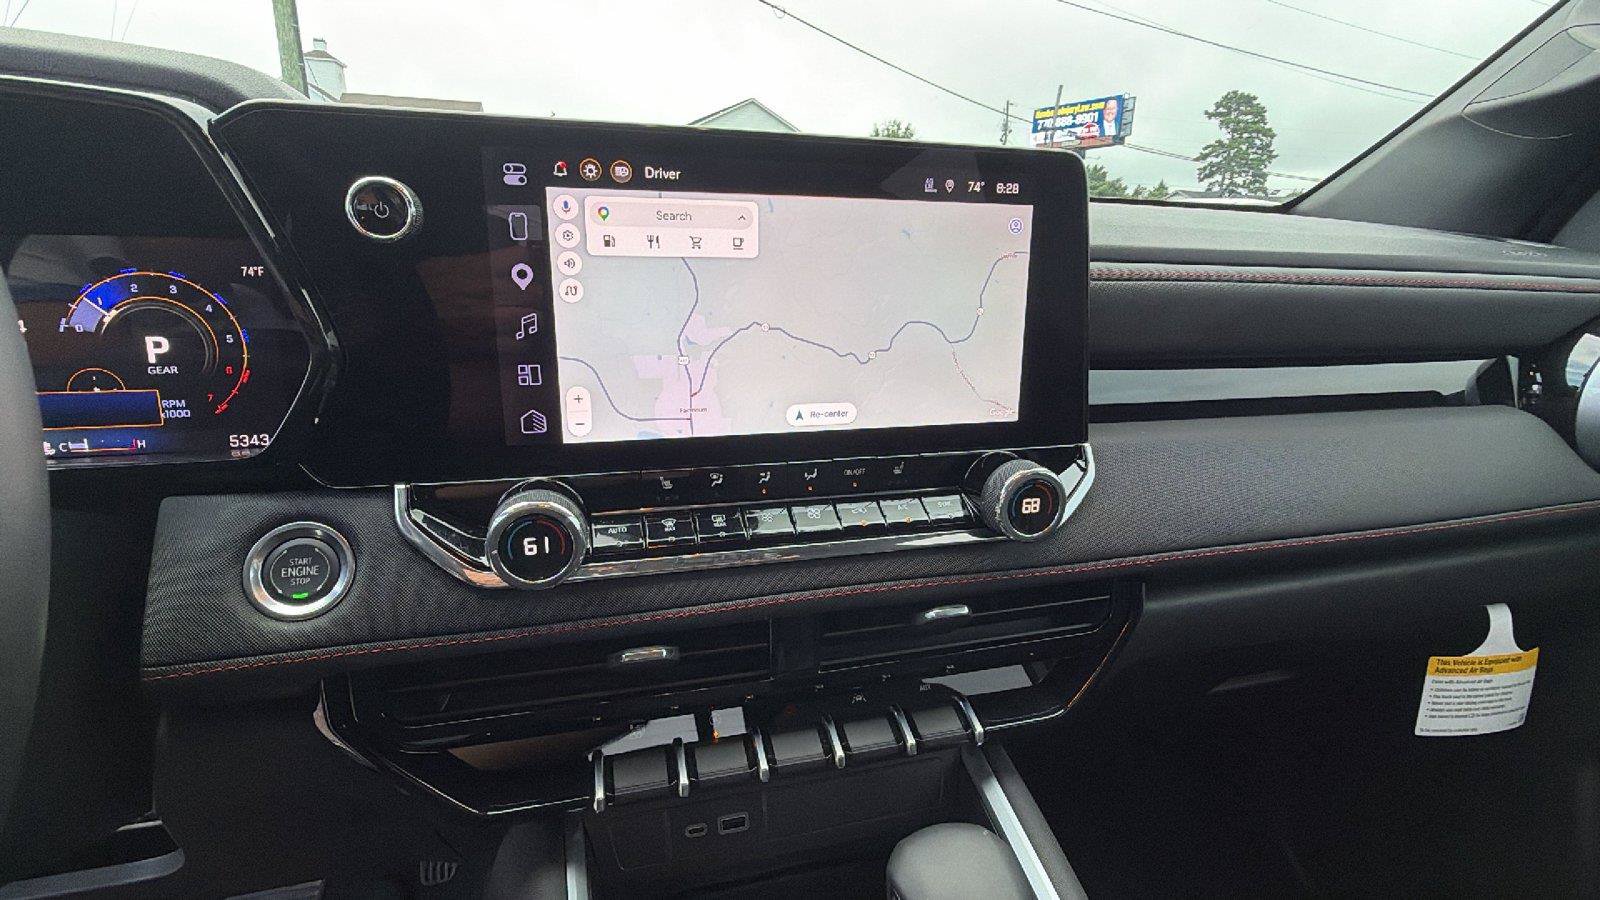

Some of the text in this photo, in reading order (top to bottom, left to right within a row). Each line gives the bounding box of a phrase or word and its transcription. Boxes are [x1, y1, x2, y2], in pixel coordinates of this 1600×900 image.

[644, 166, 682, 180] Driver
[967, 181, 1019, 194] 74° 8:28
[655, 210, 692, 222] Search
[240, 266, 264, 277] 74°F
[130, 283, 139, 293] 2
[169, 285, 178, 294] 3
[204, 303, 213, 313] 4
[226, 334, 234, 343] 5
[145, 336, 170, 363] P
[147, 366, 179, 375] GEAR
[225, 366, 233, 375] 6
[207, 393, 214, 402] 7
[161, 399, 186, 408] RPM
[809, 409, 849, 419] Re-center
[59, 439, 146, 453] C H
[229, 434, 271, 448] 5343
[1022, 498, 1040, 514] 68
[608, 526, 627, 534] AUTO
[523, 536, 550, 556] 61
[289, 557, 312, 566] START
[281, 565, 320, 578] ENGINE
[290, 577, 311, 586] STOP
[1453, 658, 1476, 666] Vehicle
[1435, 666, 1469, 674] Advanced
